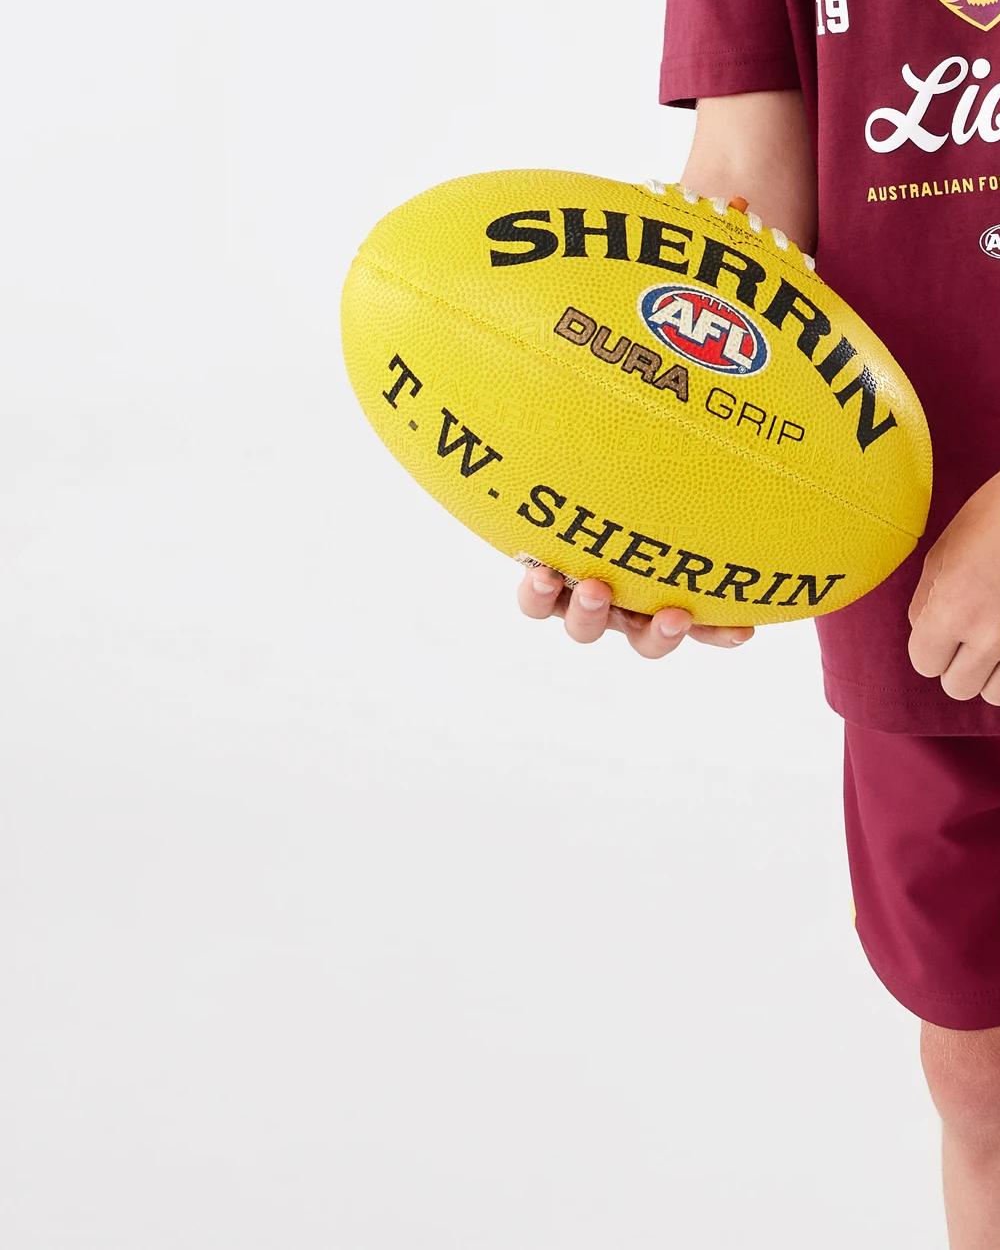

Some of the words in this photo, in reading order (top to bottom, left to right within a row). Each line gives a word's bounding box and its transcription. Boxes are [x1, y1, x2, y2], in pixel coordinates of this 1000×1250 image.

[867, 177, 974, 203] AUSTRALIAN
[486, 208, 897, 454] SHERRIN
[554, 306, 691, 404] DURA
[705, 387, 806, 445] GRIP
[648, 295, 754, 370] AFL
[516, 485, 846, 608] SHERRIN
